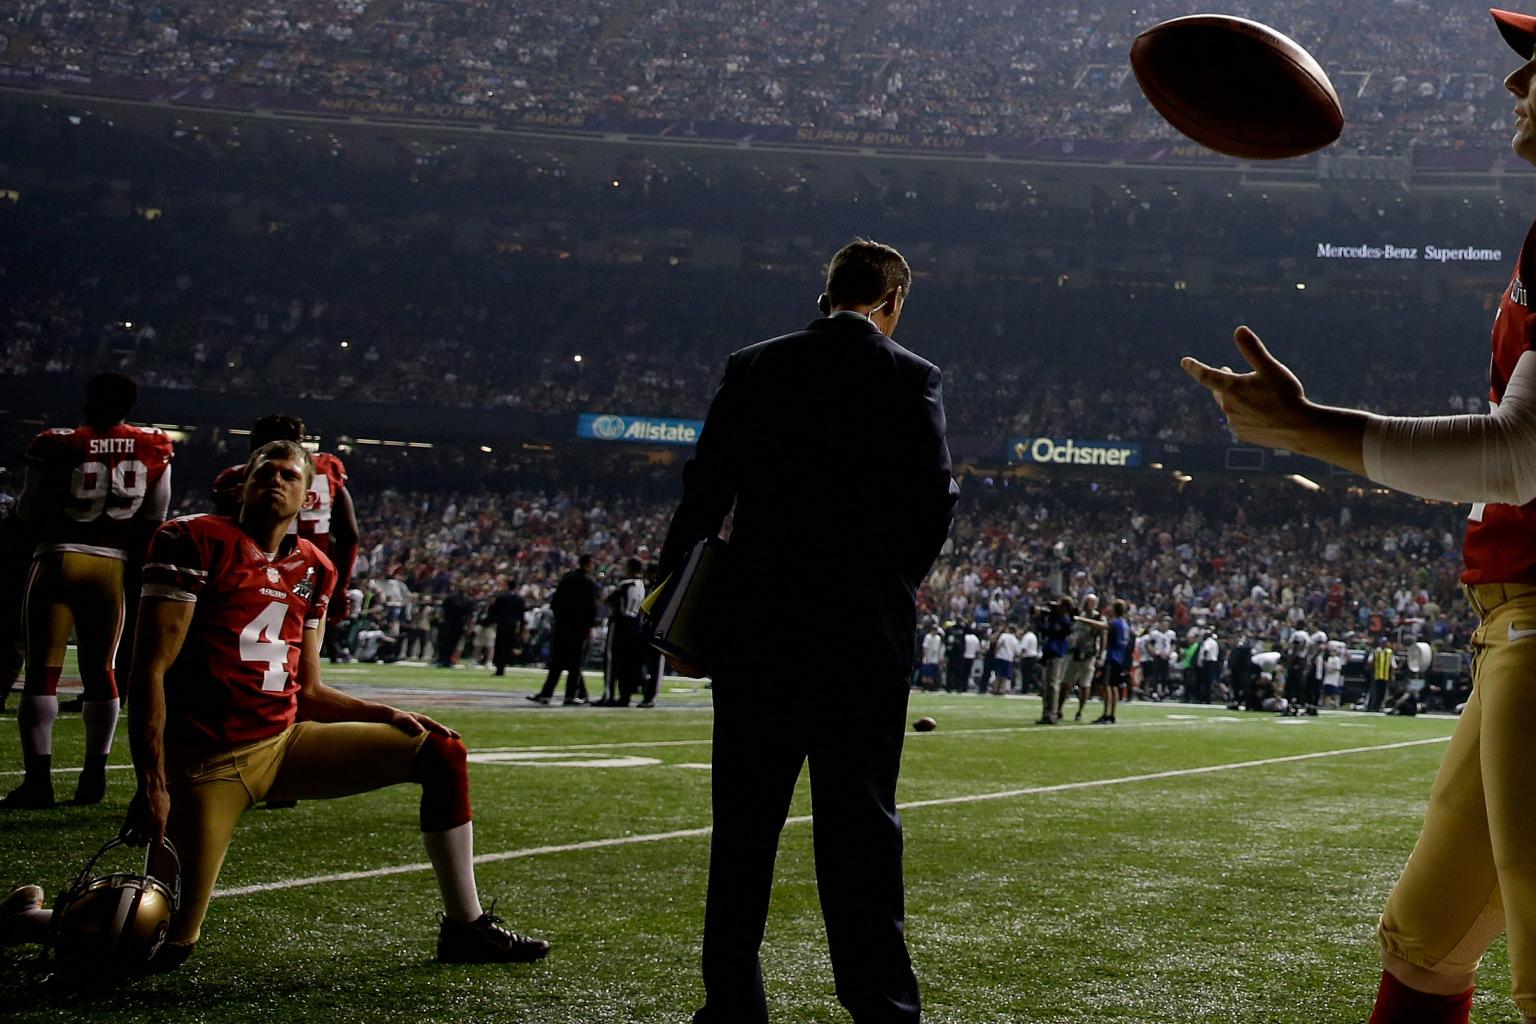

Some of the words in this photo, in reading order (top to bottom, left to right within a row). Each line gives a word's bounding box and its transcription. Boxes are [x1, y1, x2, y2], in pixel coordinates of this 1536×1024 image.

[797, 128, 859, 143] SUPER
[862, 131, 914, 145] BOWL
[921, 134, 967, 148] XLVII
[1316, 243, 1418, 260] Mercedes-Benz
[1423, 245, 1503, 263] Superdome
[623, 420, 696, 442] Allstate
[89, 438, 136, 454] SMITH
[1031, 437, 1131, 466] Ochsner
[64, 459, 149, 523] 99
[239, 600, 290, 692] 4
